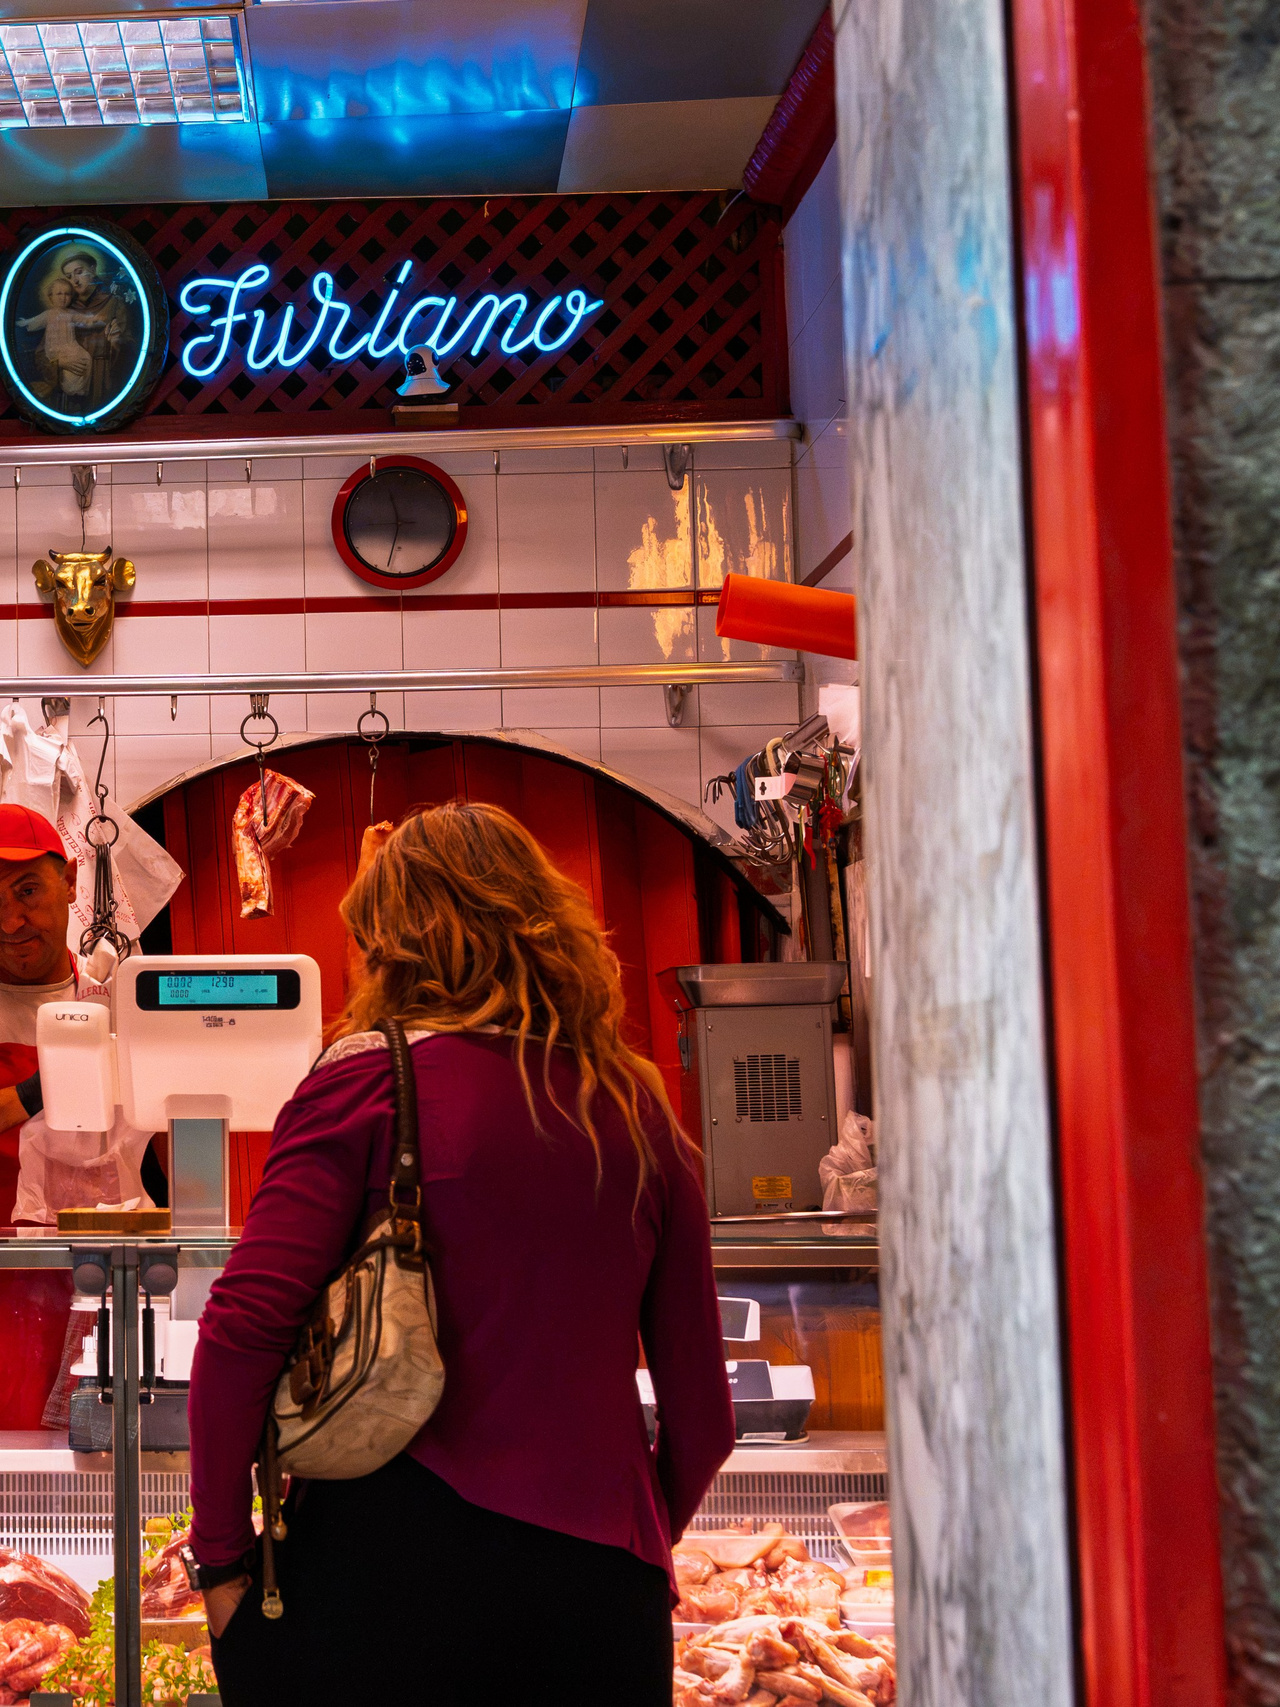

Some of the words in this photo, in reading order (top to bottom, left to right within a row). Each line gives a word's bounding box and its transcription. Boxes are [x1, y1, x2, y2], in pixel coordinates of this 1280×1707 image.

[179, 258, 605, 378] Furiano
[56, 815, 86, 867] MACELLERIA
[211, 976, 235, 988] 12.90
